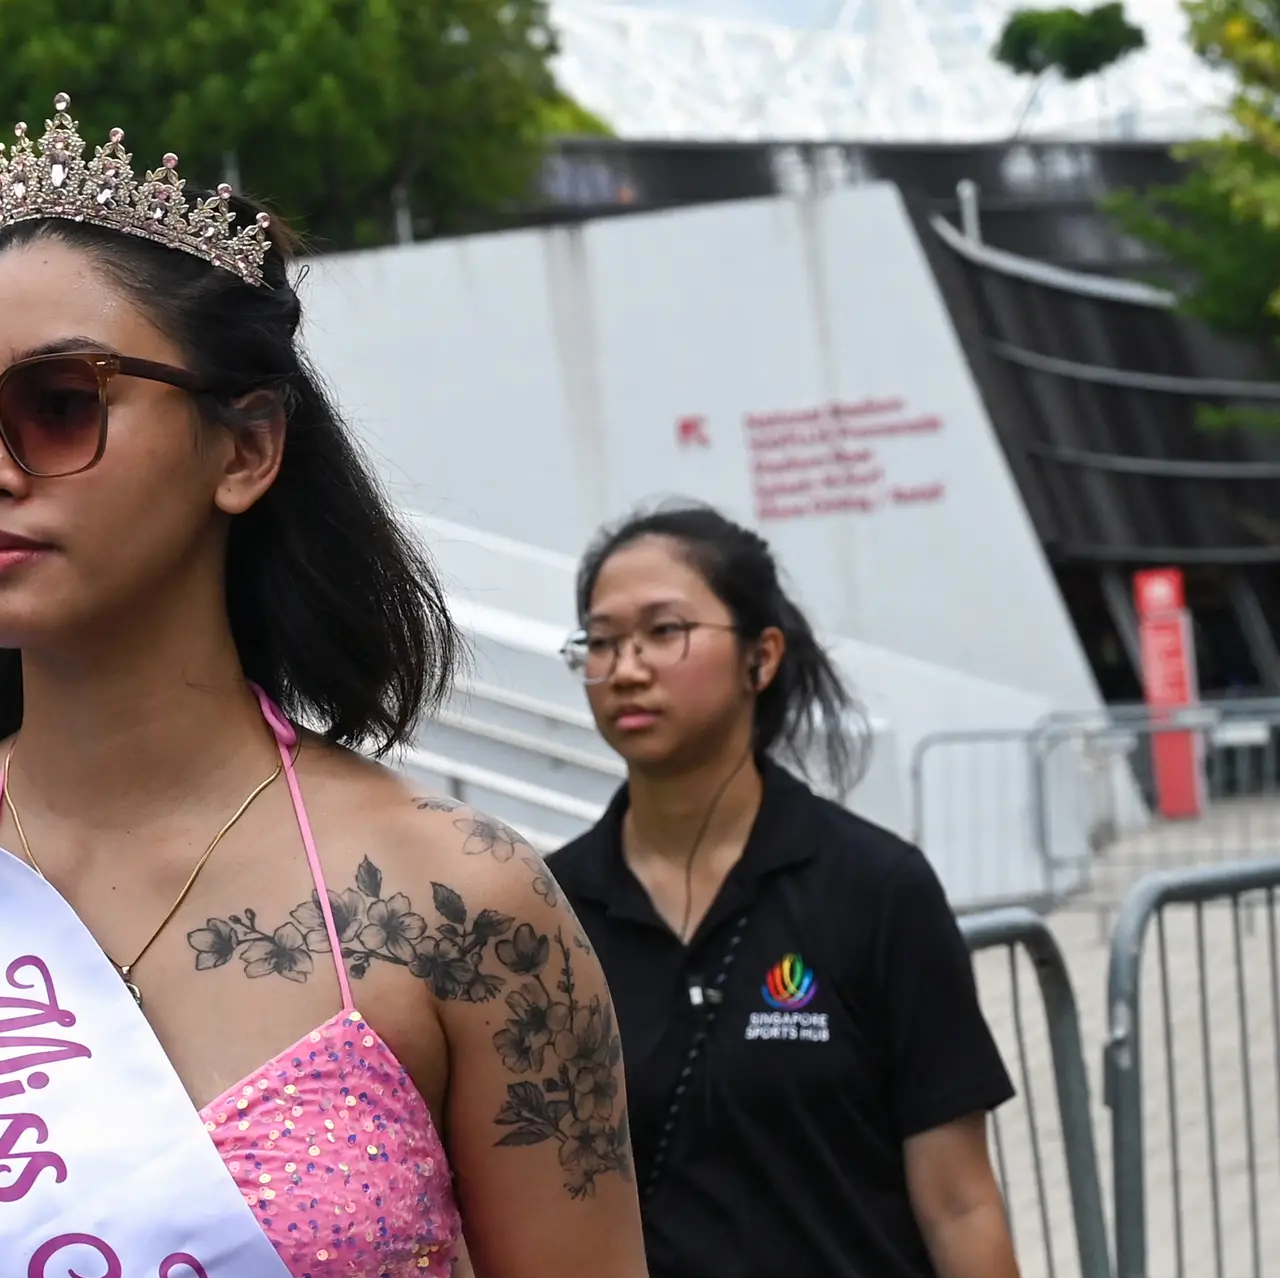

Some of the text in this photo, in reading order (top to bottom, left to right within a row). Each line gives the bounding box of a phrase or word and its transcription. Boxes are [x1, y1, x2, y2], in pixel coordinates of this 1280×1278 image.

[749, 1012, 829, 1026] SINGAPORE
[745, 1025, 830, 1042] SPORTS HUB
